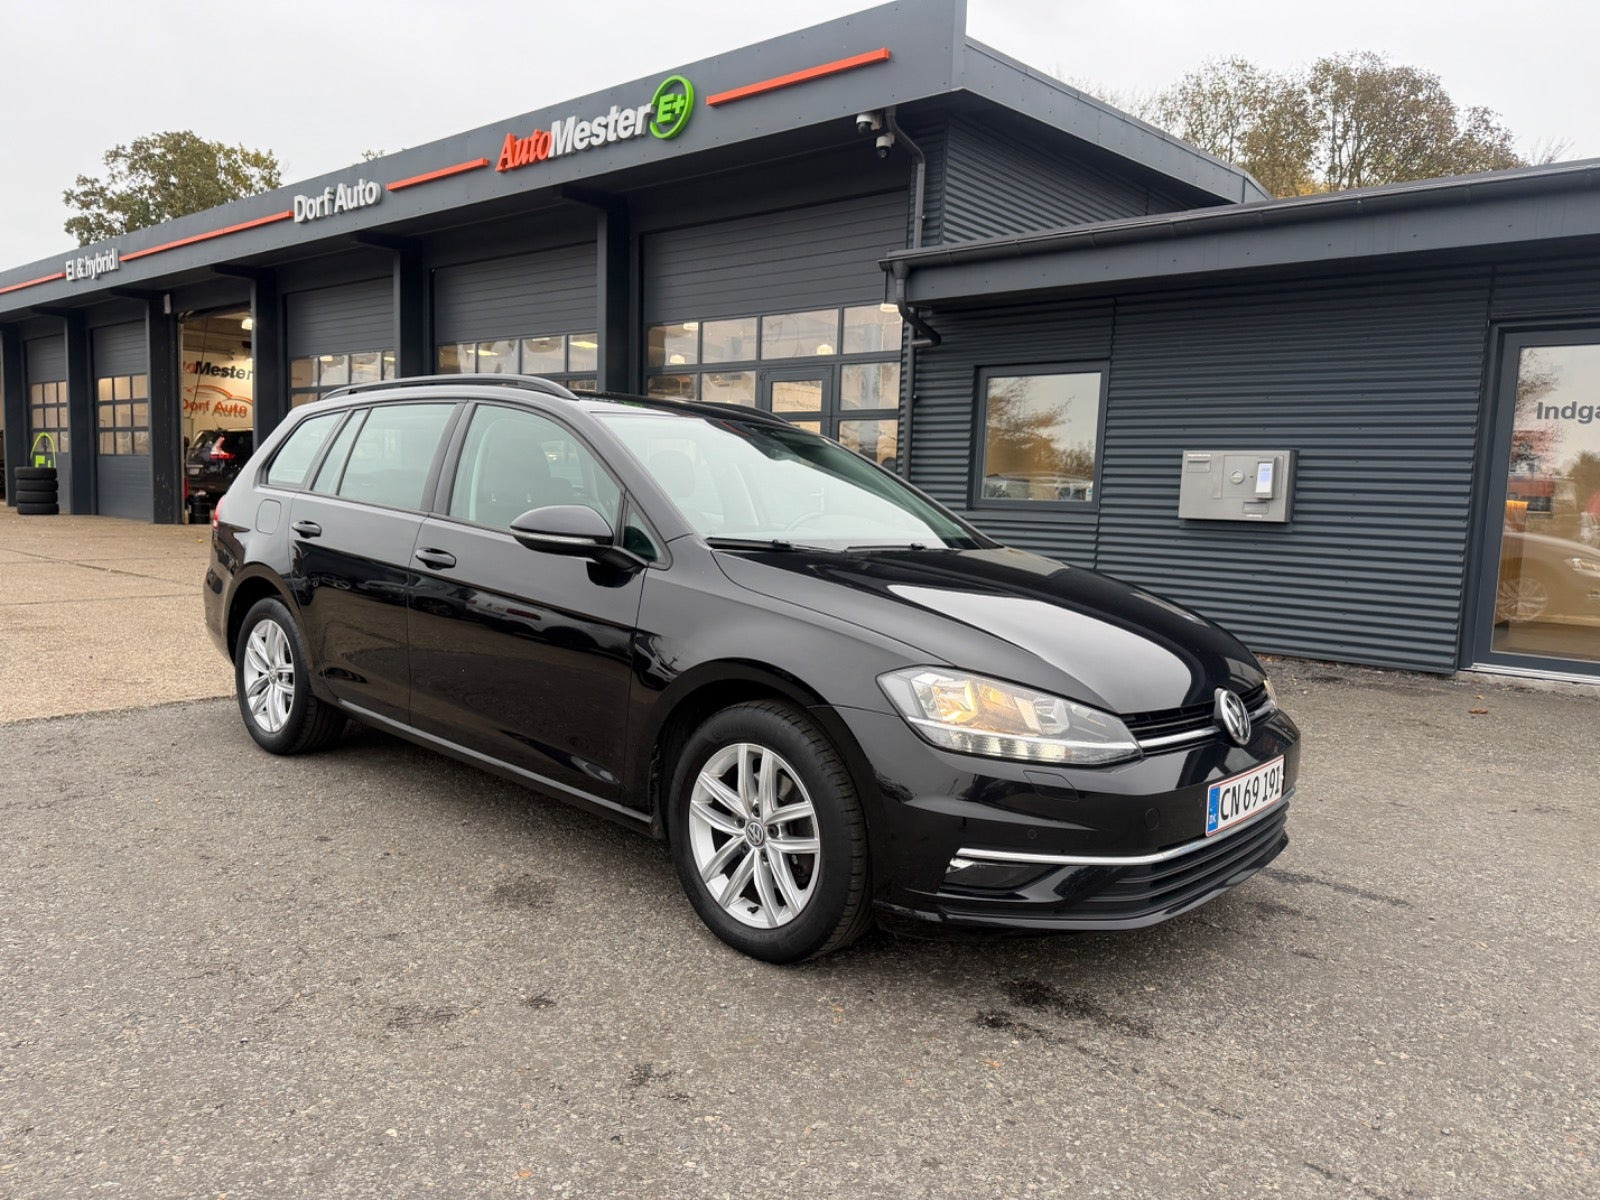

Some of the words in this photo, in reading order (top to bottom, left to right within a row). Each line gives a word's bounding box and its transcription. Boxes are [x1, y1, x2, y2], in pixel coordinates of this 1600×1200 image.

[495, 103, 653, 172] AutoMester
[294, 194, 335, 223] Dorf
[334, 178, 382, 213] Auto
[65, 259, 77, 281] El
[77, 257, 86, 278] &
[85, 247, 119, 280] hybrid
[1220, 784, 1241, 820] CN
[1243, 779, 1260, 811] 69
[1262, 765, 1281, 802] 191
